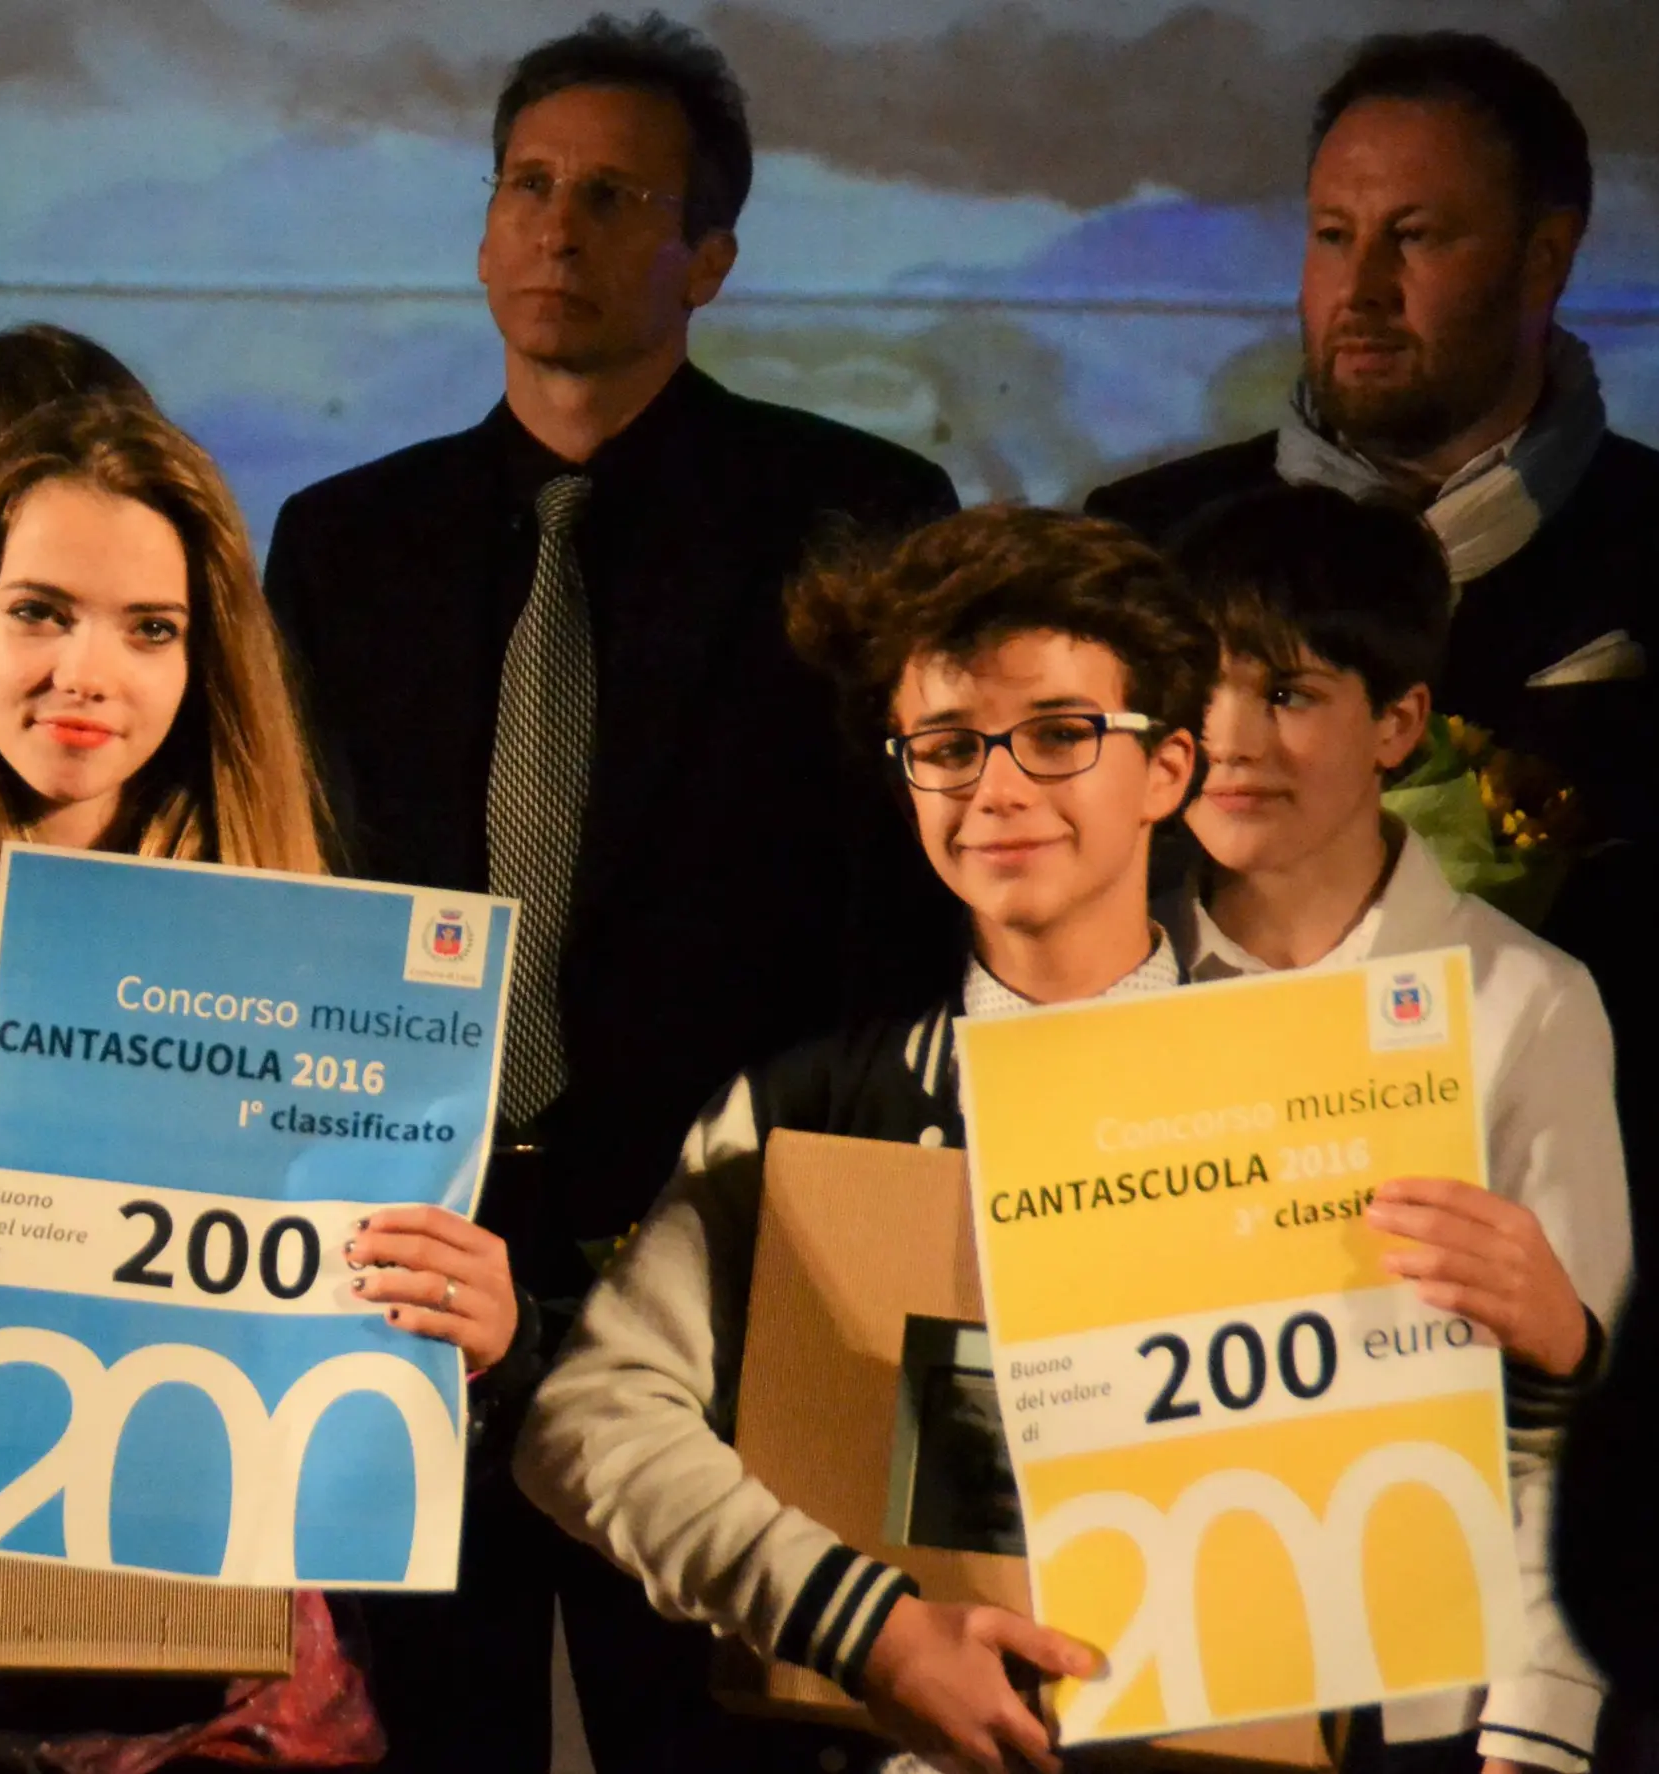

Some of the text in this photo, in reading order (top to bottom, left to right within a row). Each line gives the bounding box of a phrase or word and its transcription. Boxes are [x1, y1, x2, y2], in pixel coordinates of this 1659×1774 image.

[116, 975, 484, 1049] Concorso musicale
[290, 1053, 386, 1094] 2016
[270, 1104, 456, 1143] classificato
[1093, 1071, 1460, 1153] Concorso musicale
[990, 1137, 1371, 1224] CANTASCUOLA 2016
[1274, 1187, 1376, 1230] classif
[21, 1221, 89, 1244] valore
[112, 1199, 321, 1300] 200
[1009, 1354, 1073, 1380] Buono
[1136, 1310, 1474, 1424] 200 euro
[1015, 1381, 1112, 1412] del valore
[1021, 1421, 1040, 1443] di
[1029, 1440, 1525, 1742] 200
